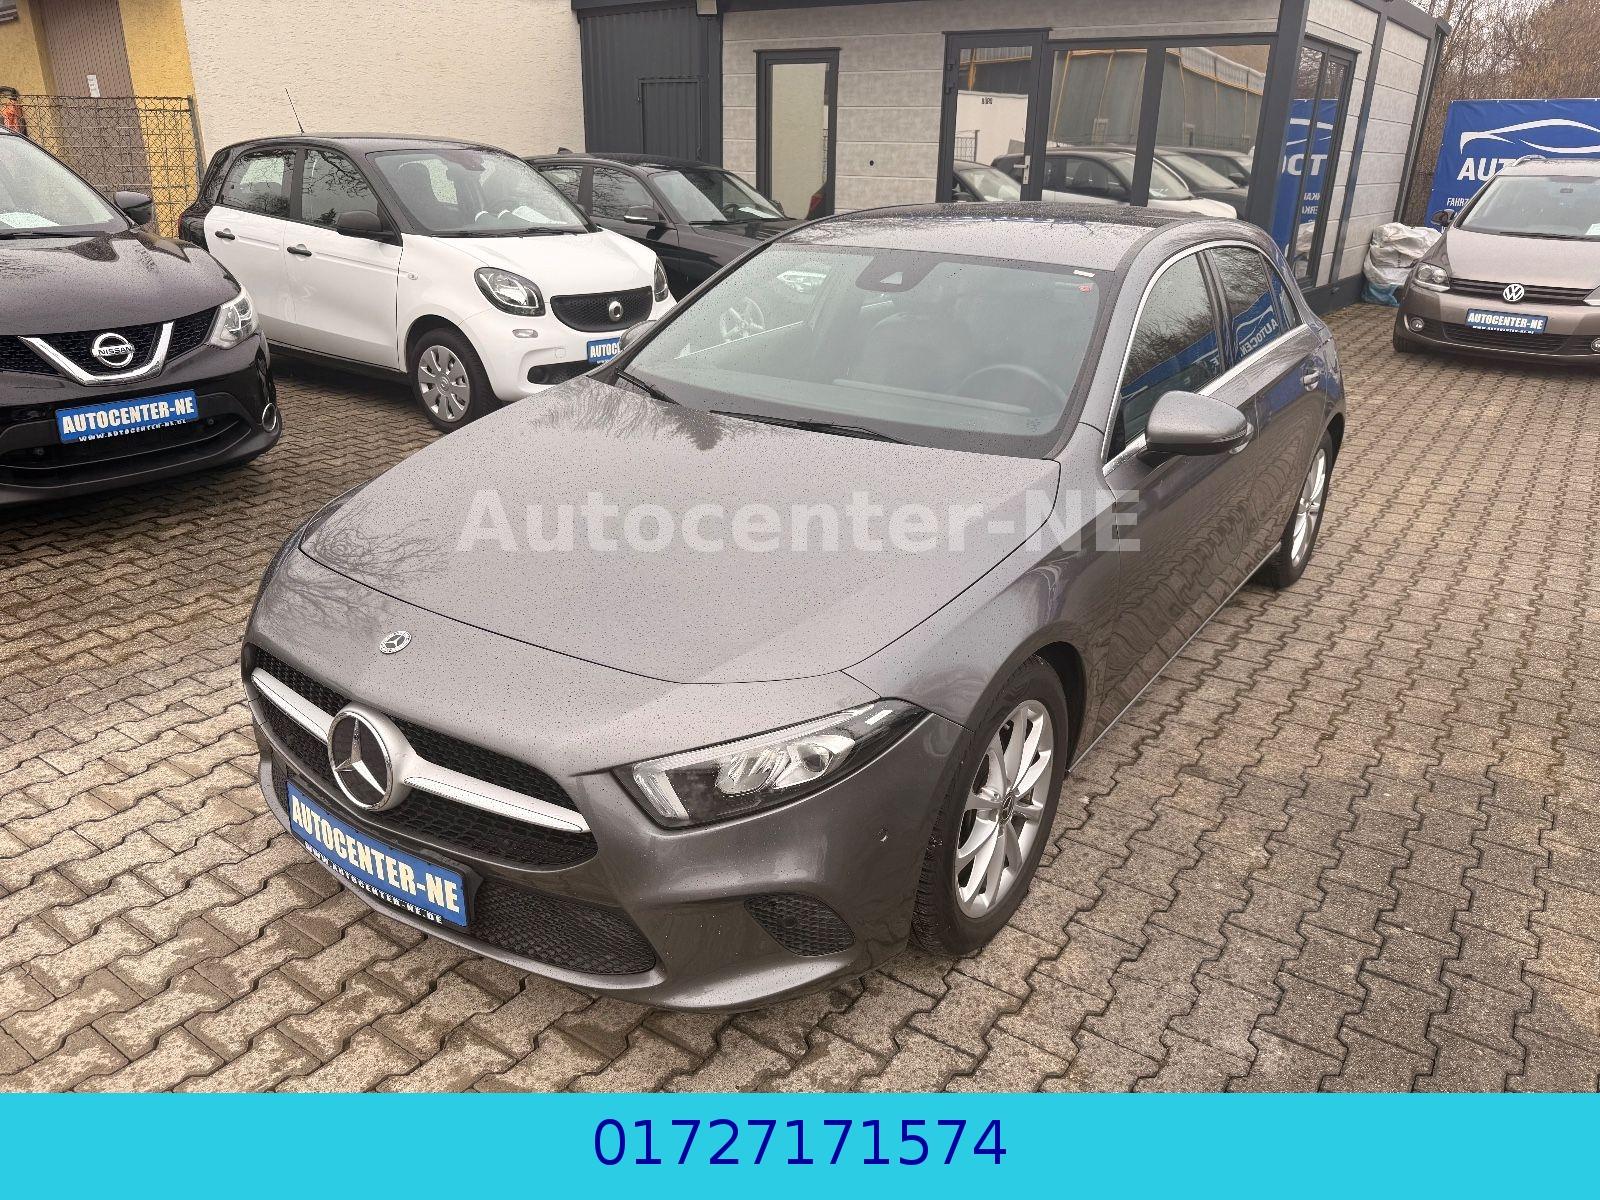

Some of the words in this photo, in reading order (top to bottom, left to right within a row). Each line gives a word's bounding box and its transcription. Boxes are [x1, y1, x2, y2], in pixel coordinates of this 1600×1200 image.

[1467, 312, 1544, 330] AUTOCENTER-NE
[98, 346, 133, 356] NISSAN
[62, 397, 195, 435] AUTOCENTER-NE
[291, 794, 460, 913] AUTOCENTER-NE
